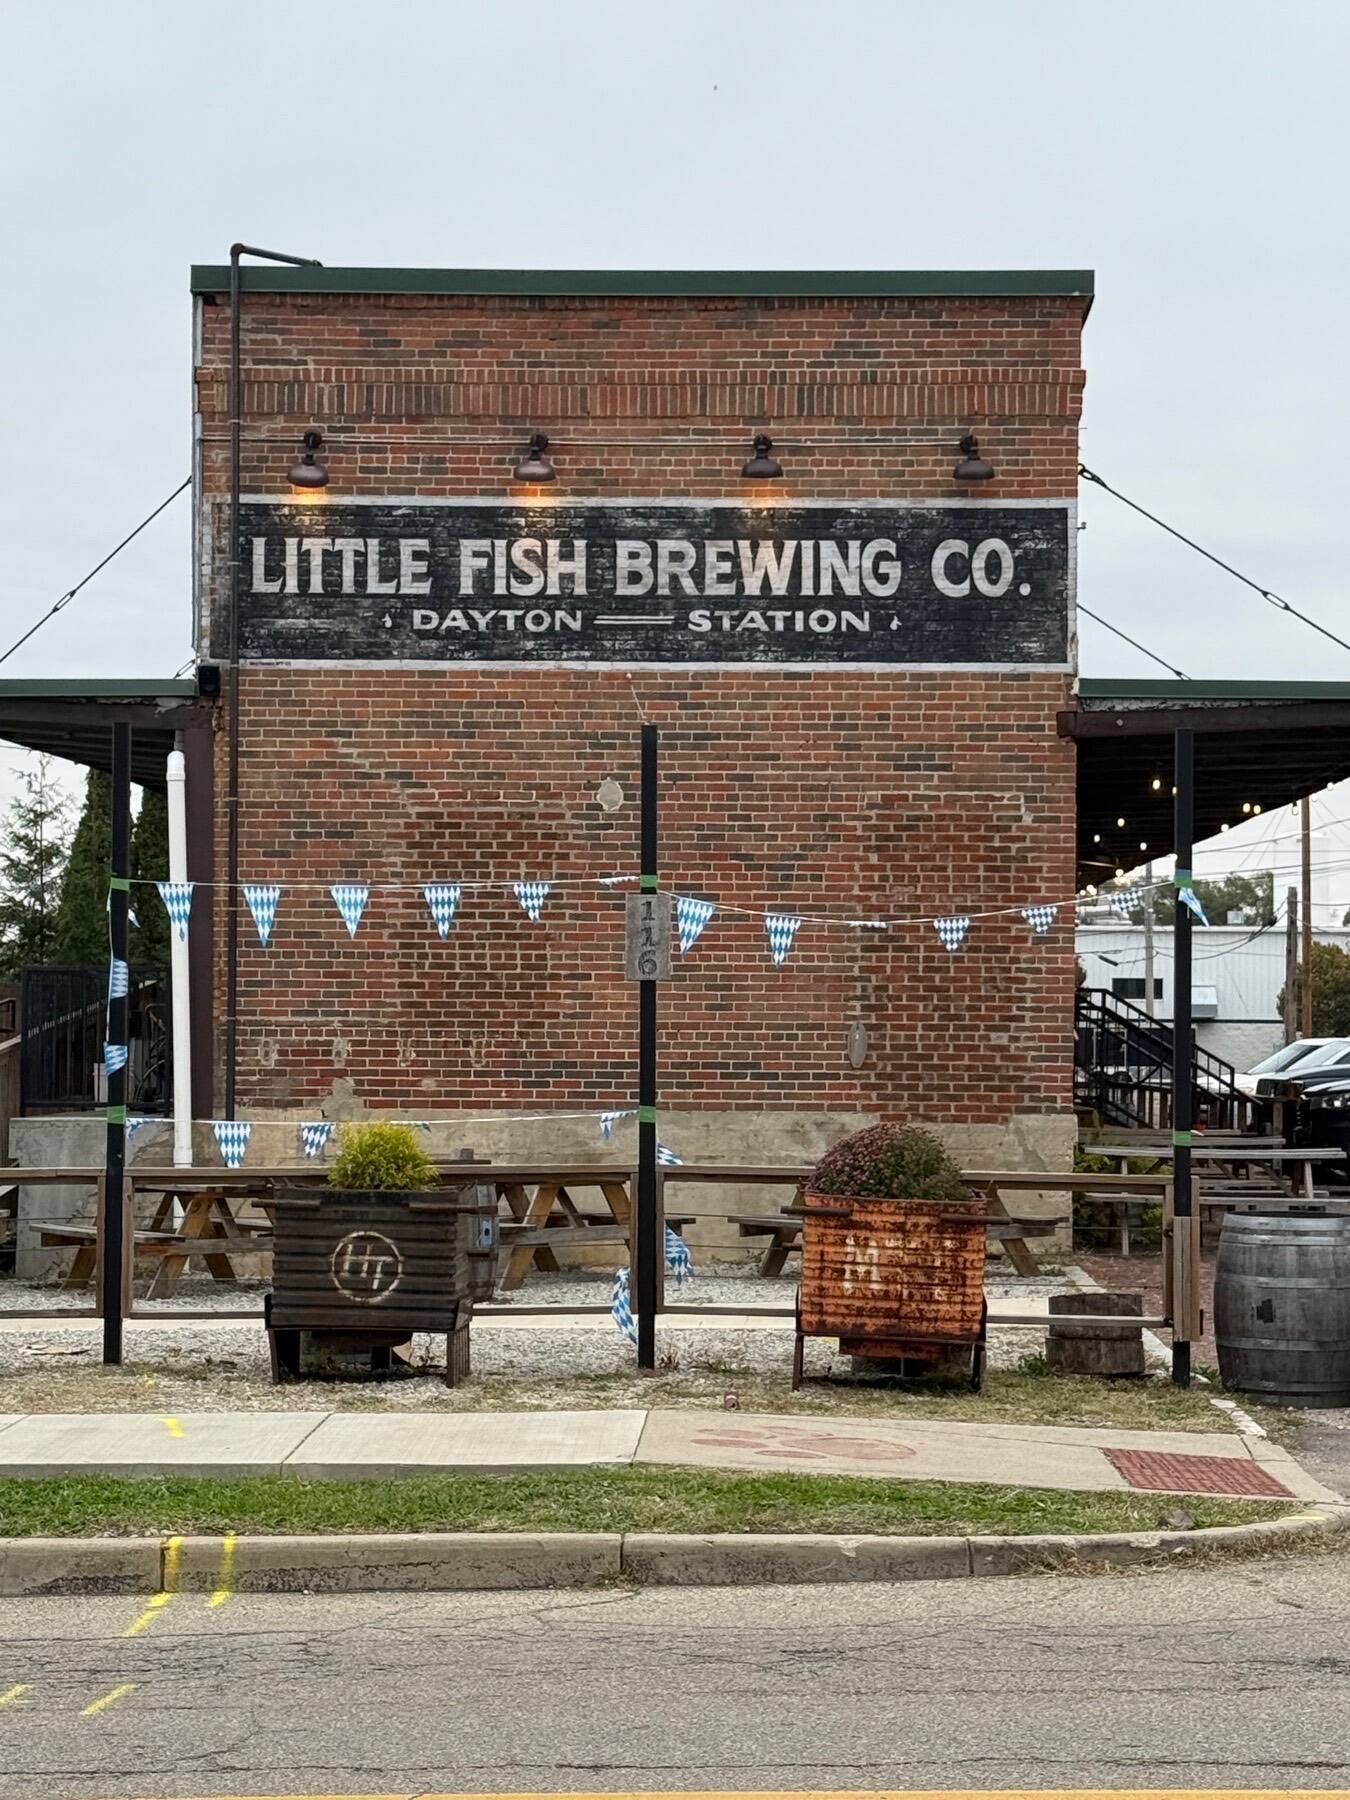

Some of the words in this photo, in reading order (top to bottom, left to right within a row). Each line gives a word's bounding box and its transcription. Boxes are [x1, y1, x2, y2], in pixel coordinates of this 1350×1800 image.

[249, 537, 432, 594] LITTLE
[459, 538, 588, 595] FISH
[614, 538, 902, 597] BREWING
[930, 538, 1032, 598] CO.
[412, 608, 582, 633] DAYTON
[687, 609, 871, 633] STATION
[638, 901, 657, 975] 116
